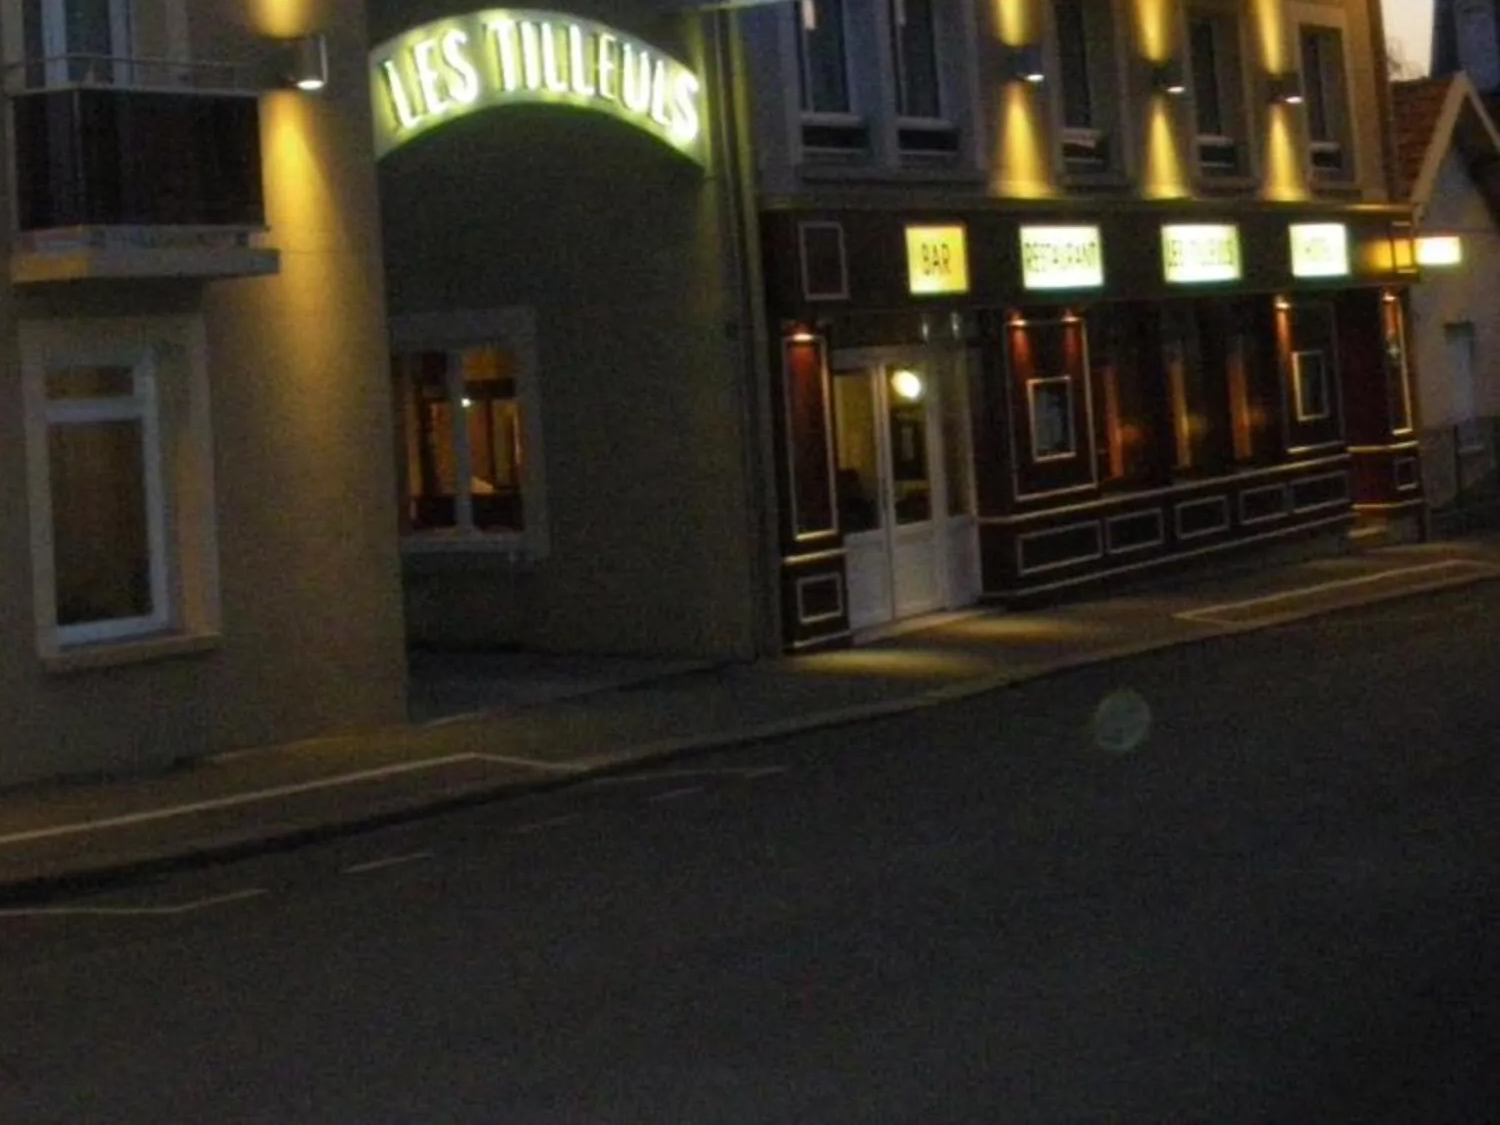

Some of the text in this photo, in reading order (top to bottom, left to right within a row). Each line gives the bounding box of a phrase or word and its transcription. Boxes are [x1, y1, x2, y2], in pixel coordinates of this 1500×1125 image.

[385, 19, 700, 144] LES TILLEULS
[921, 243, 951, 275] BAR
